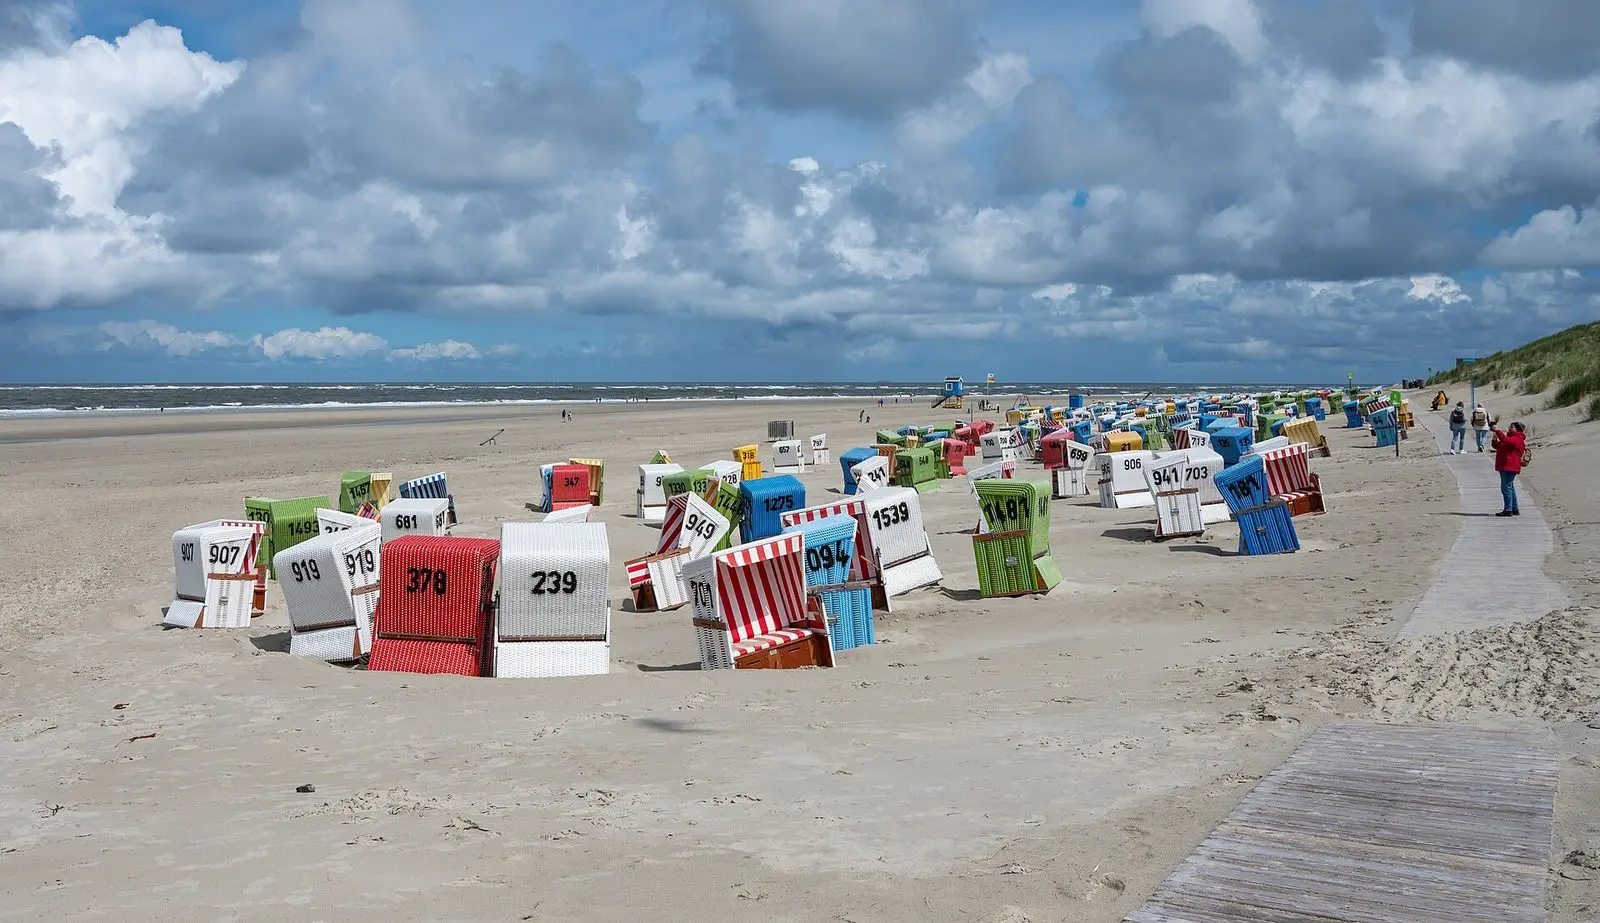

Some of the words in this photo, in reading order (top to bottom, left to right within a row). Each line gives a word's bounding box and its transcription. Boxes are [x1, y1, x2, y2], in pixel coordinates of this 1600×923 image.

[984, 438, 995, 447] 700
[1121, 443, 1131, 451] 21
[1191, 437, 1206, 447] 713
[743, 451, 755, 460] 318
[1070, 448, 1088, 461] 699
[1124, 458, 1142, 471] 906
[867, 466, 886, 482] 241
[1152, 467, 1179, 486] 941
[1185, 466, 1208, 482] 703
[692, 480, 707, 493] 133
[764, 493, 794, 513] 1275
[396, 514, 418, 530] 681
[872, 501, 909, 531] 1539
[287, 520, 320, 537] 1493
[685, 513, 716, 541] 949
[181, 543, 194, 563] 907
[208, 544, 241, 567] 907
[291, 558, 321, 583] 919
[346, 549, 375, 577] 919
[406, 567, 448, 596] 378
[531, 570, 578, 595] 239
